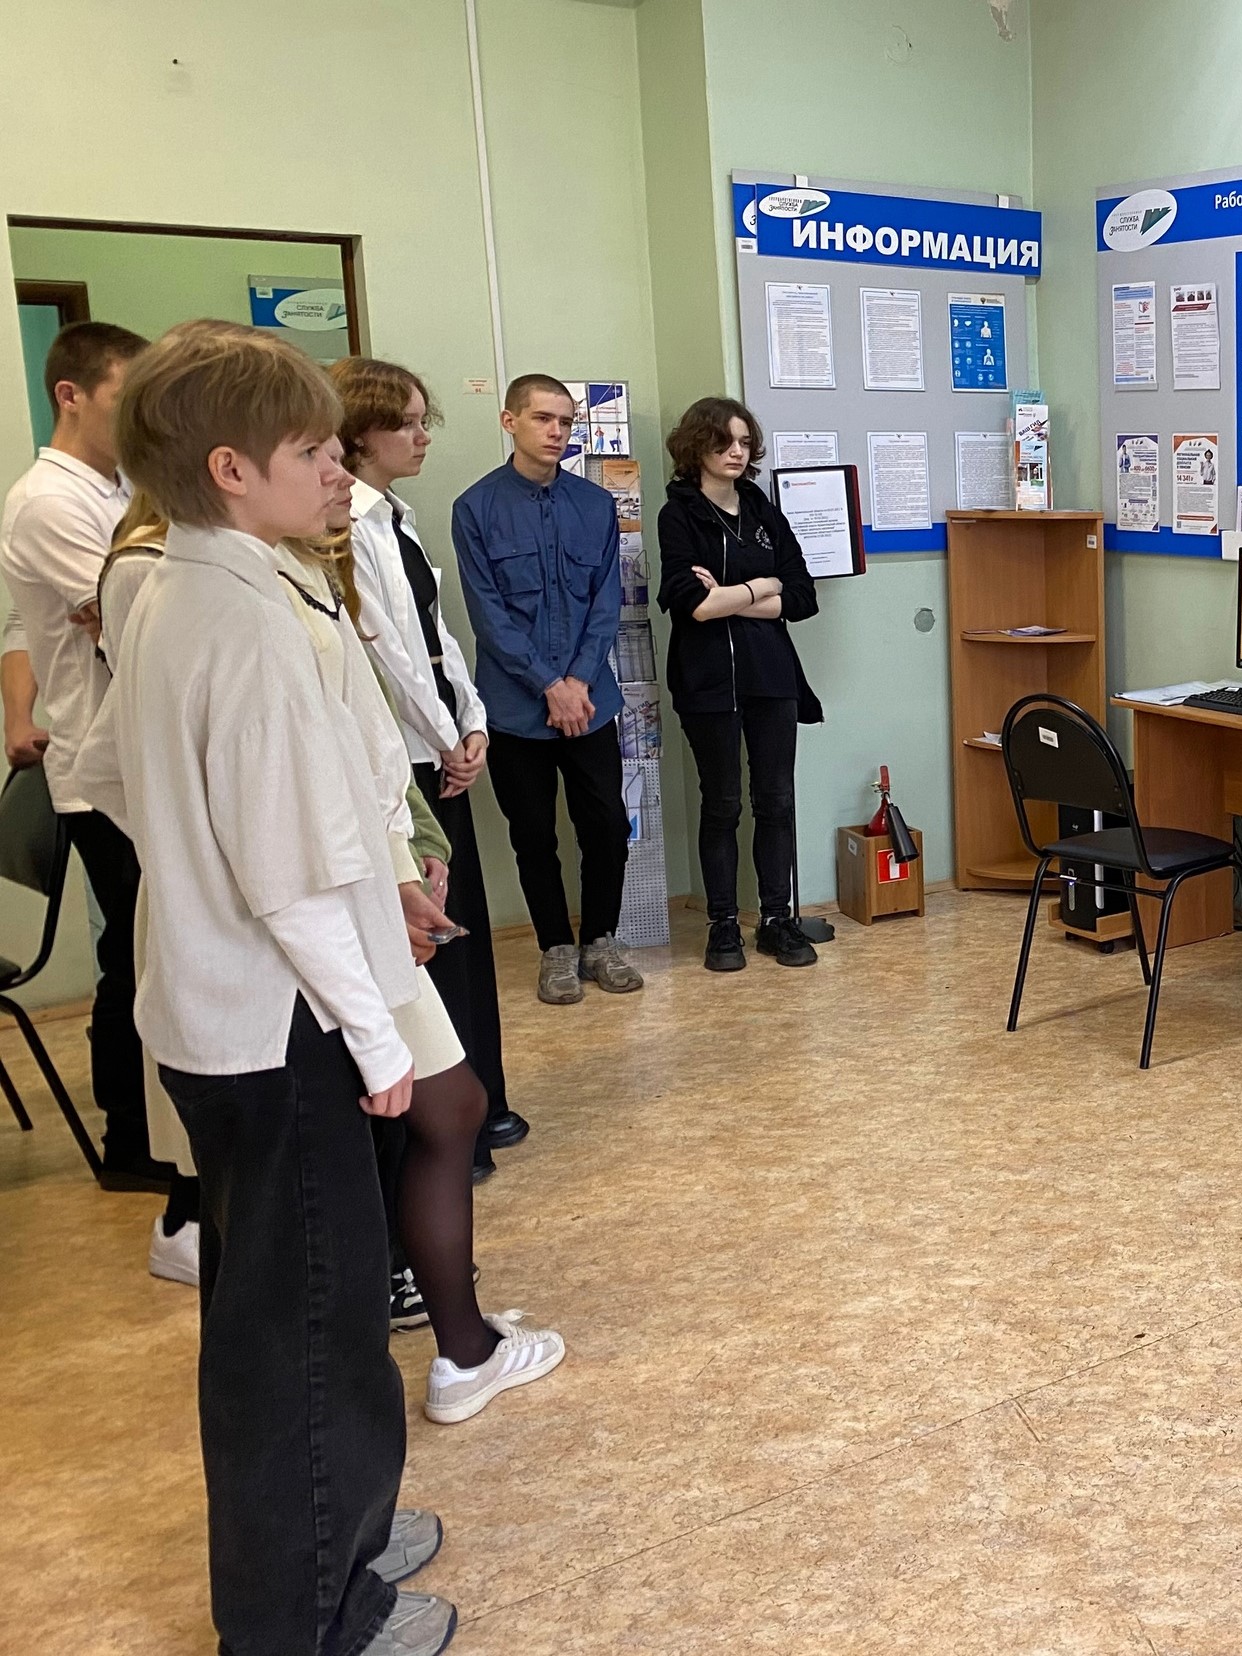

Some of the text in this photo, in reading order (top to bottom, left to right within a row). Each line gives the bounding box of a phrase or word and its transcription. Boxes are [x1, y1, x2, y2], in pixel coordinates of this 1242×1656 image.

[1119, 215, 1140, 224] СЛУЖБА
[1108, 223, 1138, 237] ЗАНЯТОСТИ
[792, 219, 1039, 269] ИНФОРМАЦИЯ
